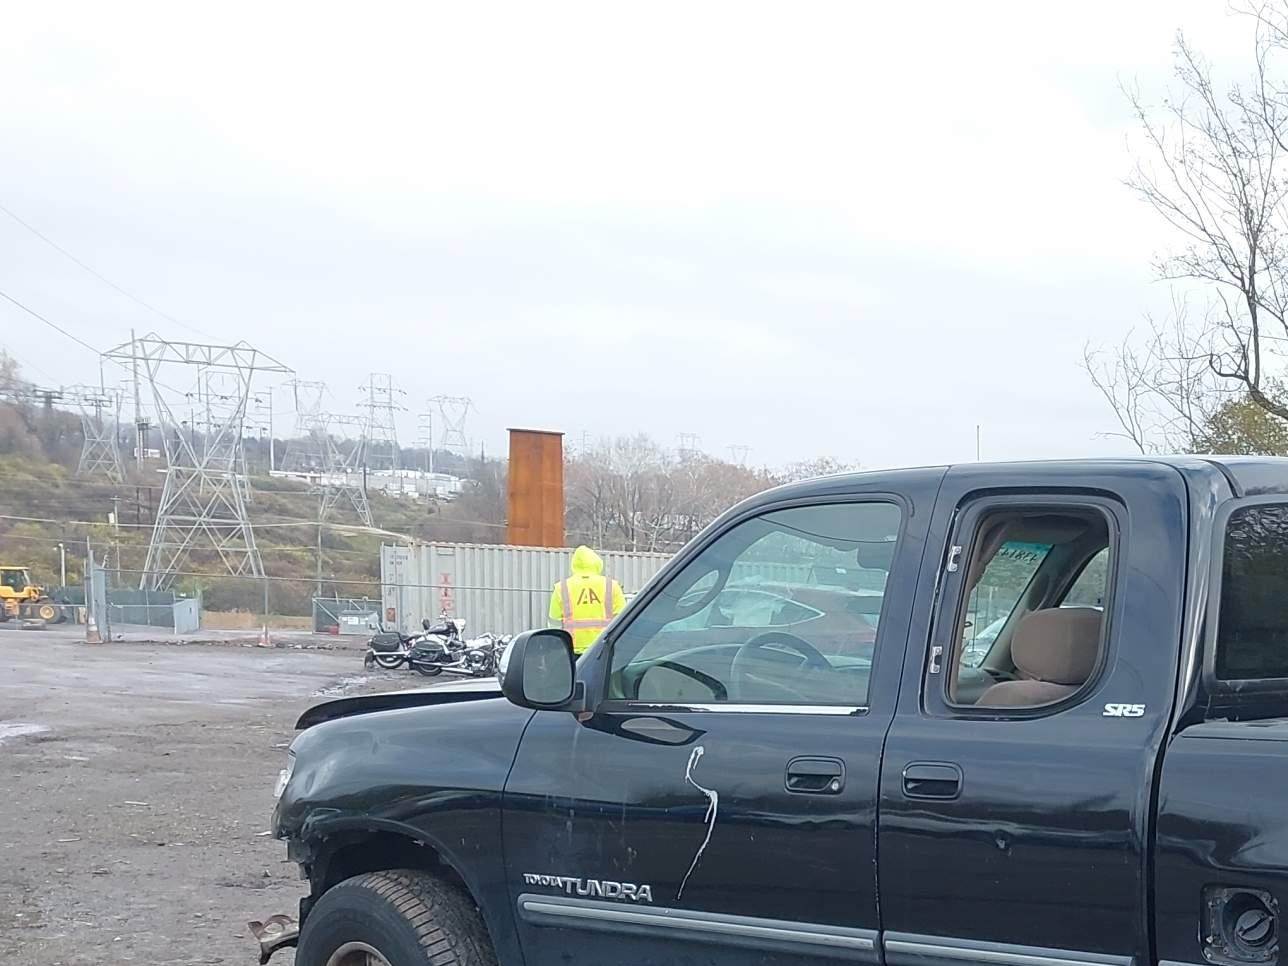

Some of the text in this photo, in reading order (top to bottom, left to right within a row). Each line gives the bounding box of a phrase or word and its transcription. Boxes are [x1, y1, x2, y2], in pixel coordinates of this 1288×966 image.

[1103, 703, 1146, 717] SR5
[523, 873, 653, 902] TOYOTA TUNDRA
